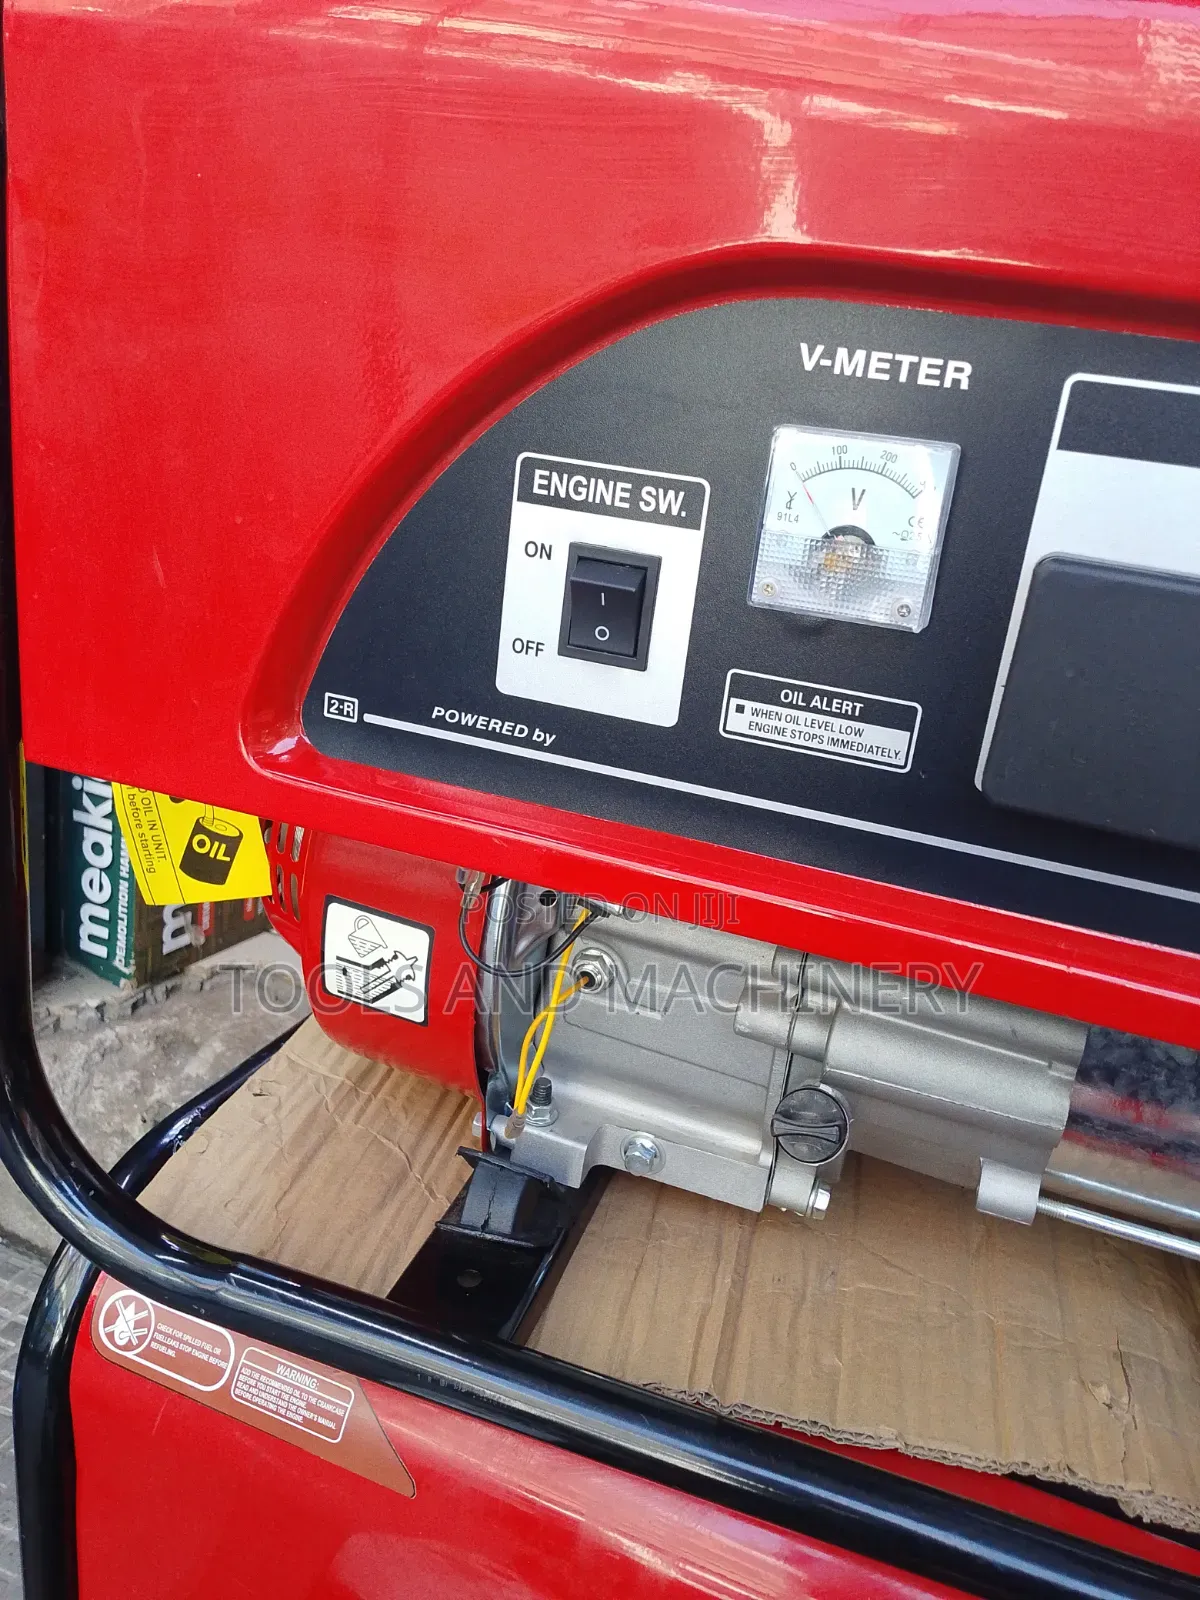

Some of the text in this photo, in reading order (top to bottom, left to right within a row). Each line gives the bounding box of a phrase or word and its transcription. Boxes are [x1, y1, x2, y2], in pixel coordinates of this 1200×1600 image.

[800, 342, 973, 390] V-METER
[831, 444, 848, 455] 100
[879, 450, 898, 464] 200
[789, 461, 797, 471] 0
[532, 468, 687, 518] ENGINE SW.
[851, 487, 866, 511] V
[776, 511, 800, 524] 91L4
[524, 540, 552, 561] ON
[512, 637, 545, 658] OFF
[780, 689, 864, 717] OIL ALERT
[431, 706, 556, 747] POWERED by
[750, 706, 865, 738] WHEN OIL LEVEL LOW
[748, 721, 902, 761] ENGINE STOPS IMMEDIATELY.
[140, 797, 154, 816] OIL
[128, 793, 143, 830] before
[138, 832, 156, 874] starting
[147, 819, 159, 831] IN
[151, 834, 167, 863] UNIT.
[192, 833, 231, 862] OIL
[72, 776, 113, 959] meaki
[114, 880, 129, 970] DEMOLITION
[150, 1341, 176, 1358] REFUELING.
[157, 1323, 221, 1355] CHECK FOR SPILLED FUEL OR
[179, 1343, 192, 1354] STOP
[192, 1348, 209, 1361] ENGINE
[209, 1356, 228, 1369] BEFORE
[238, 1374, 256, 1386] BEFORE
[256, 1380, 266, 1389] YOU
[266, 1384, 280, 1396] START
[281, 1390, 289, 1400] THE
[276, 1364, 319, 1390] WARNING:
[235, 1388, 252, 1400] BEFORE
[252, 1395, 278, 1411] OPERATING
[278, 1406, 286, 1415] THE
[236, 1381, 249, 1391] READ
[249, 1386, 259, 1395] AND
[259, 1389, 287, 1407] UNDERSTAND
[288, 1403, 297, 1412] THE
[241, 1367, 250, 1376] ADD
[251, 1371, 260, 1379] THE
[260, 1374, 293, 1393] RECOMMENDED
[301, 1392, 308, 1400] TO
[308, 1395, 317, 1404] THE
[317, 1398, 346, 1417] CRANKCASE
